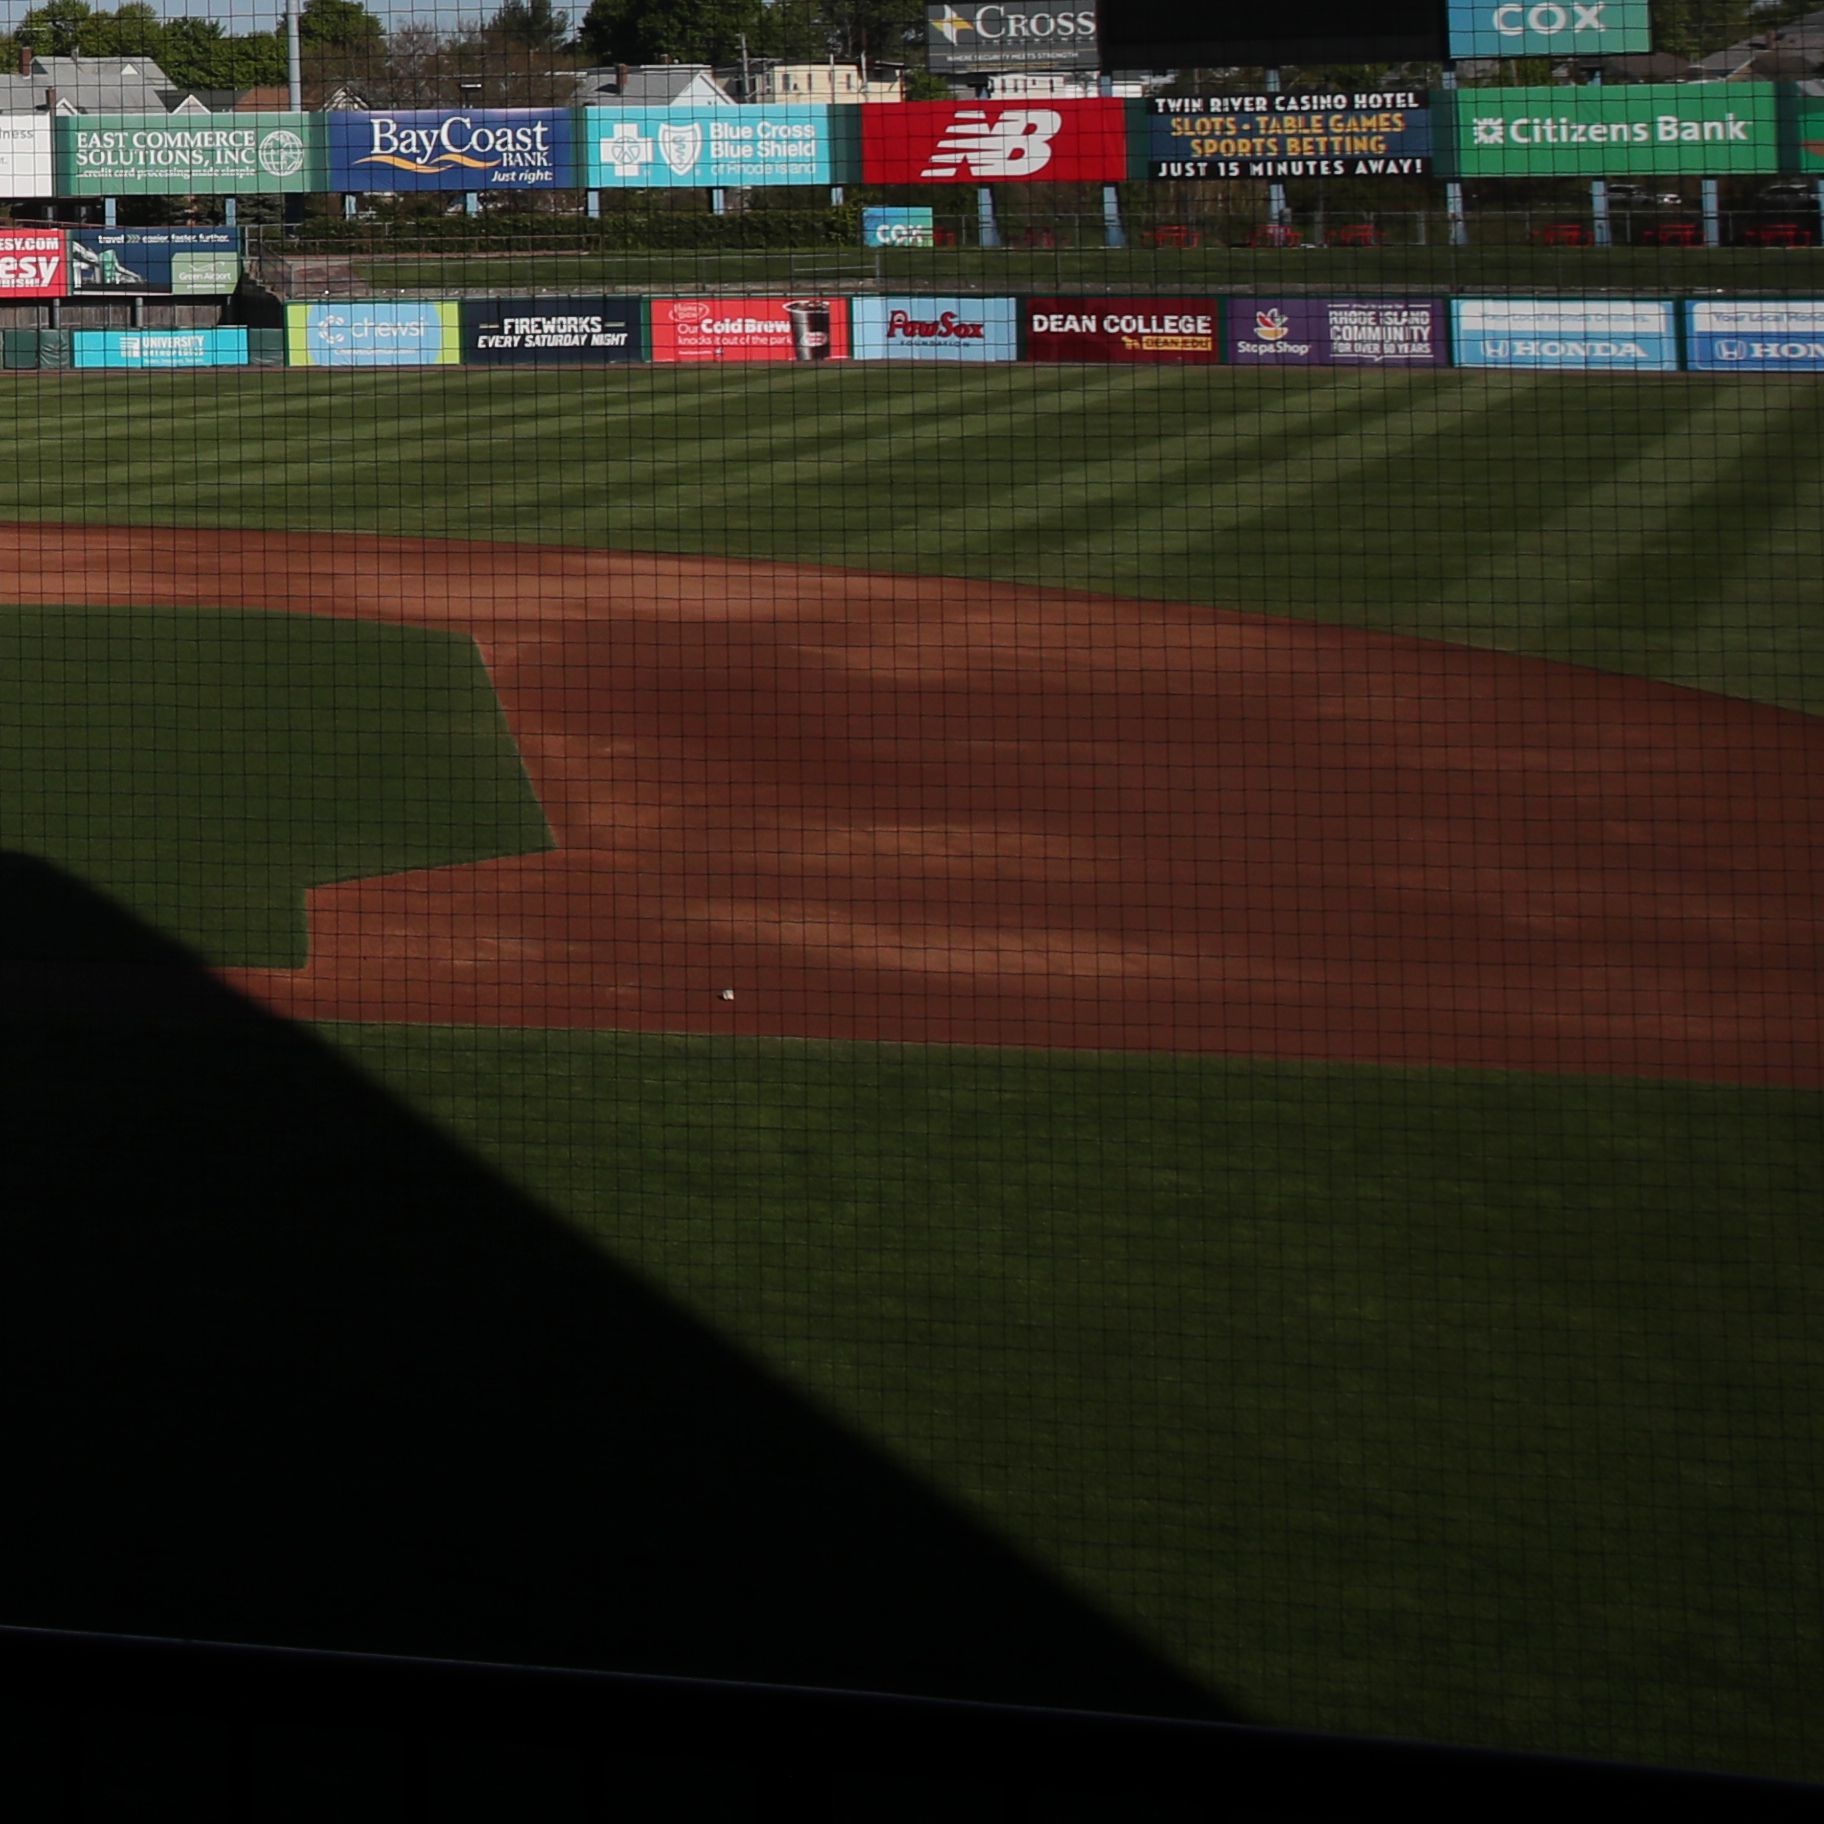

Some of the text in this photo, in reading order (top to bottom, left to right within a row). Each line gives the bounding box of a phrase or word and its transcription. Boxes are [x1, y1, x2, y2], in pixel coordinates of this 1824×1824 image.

[1493, 1, 1606, 36] COX
[1154, 92, 1420, 113] TWIN RIVER CASINO HOTEL
[710, 120, 816, 139] Blue Cross
[1170, 113, 1406, 137] SLOTS TABLE GAMES
[1509, 113, 1749, 145] Citizens Bank
[75, 130, 257, 149] EAST COMMERCE
[370, 116, 550, 165] BayCoast
[710, 139, 817, 158] Blue Shield
[1190, 136, 1388, 158] SPORTS BETTING
[75, 147, 257, 168] SOLUTIONS, INC
[491, 170, 517, 183] Just
[710, 162, 726, 176] of
[727, 162, 773, 176] Rhode
[1157, 158, 1423, 177] JUST 15 MINUTES AWAY!
[98, 234, 124, 244] travel
[179, 271, 232, 282] Green Airport
[502, 316, 603, 334] FIREWORKS
[677, 318, 792, 335] Our Cold Brew
[886, 309, 986, 340] PawSox
[1032, 313, 1213, 335] DEAN COLLEGE
[1328, 309, 1431, 326] RHODE ISLAND
[1714, 312, 1785, 323] Your Local
[350, 315, 427, 340] chewsi
[1329, 325, 1432, 342] COMMUNITY
[142, 335, 205, 348] UNIVERSITY
[477, 332, 628, 349] EVERY SATURDAY NIGHT
[677, 335, 713, 345] knocks
[721, 335, 738, 345] out
[751, 335, 769, 345] the
[1333, 342, 1432, 354] FOR OVER YEARS
[1512, 340, 1649, 358] HONDA
